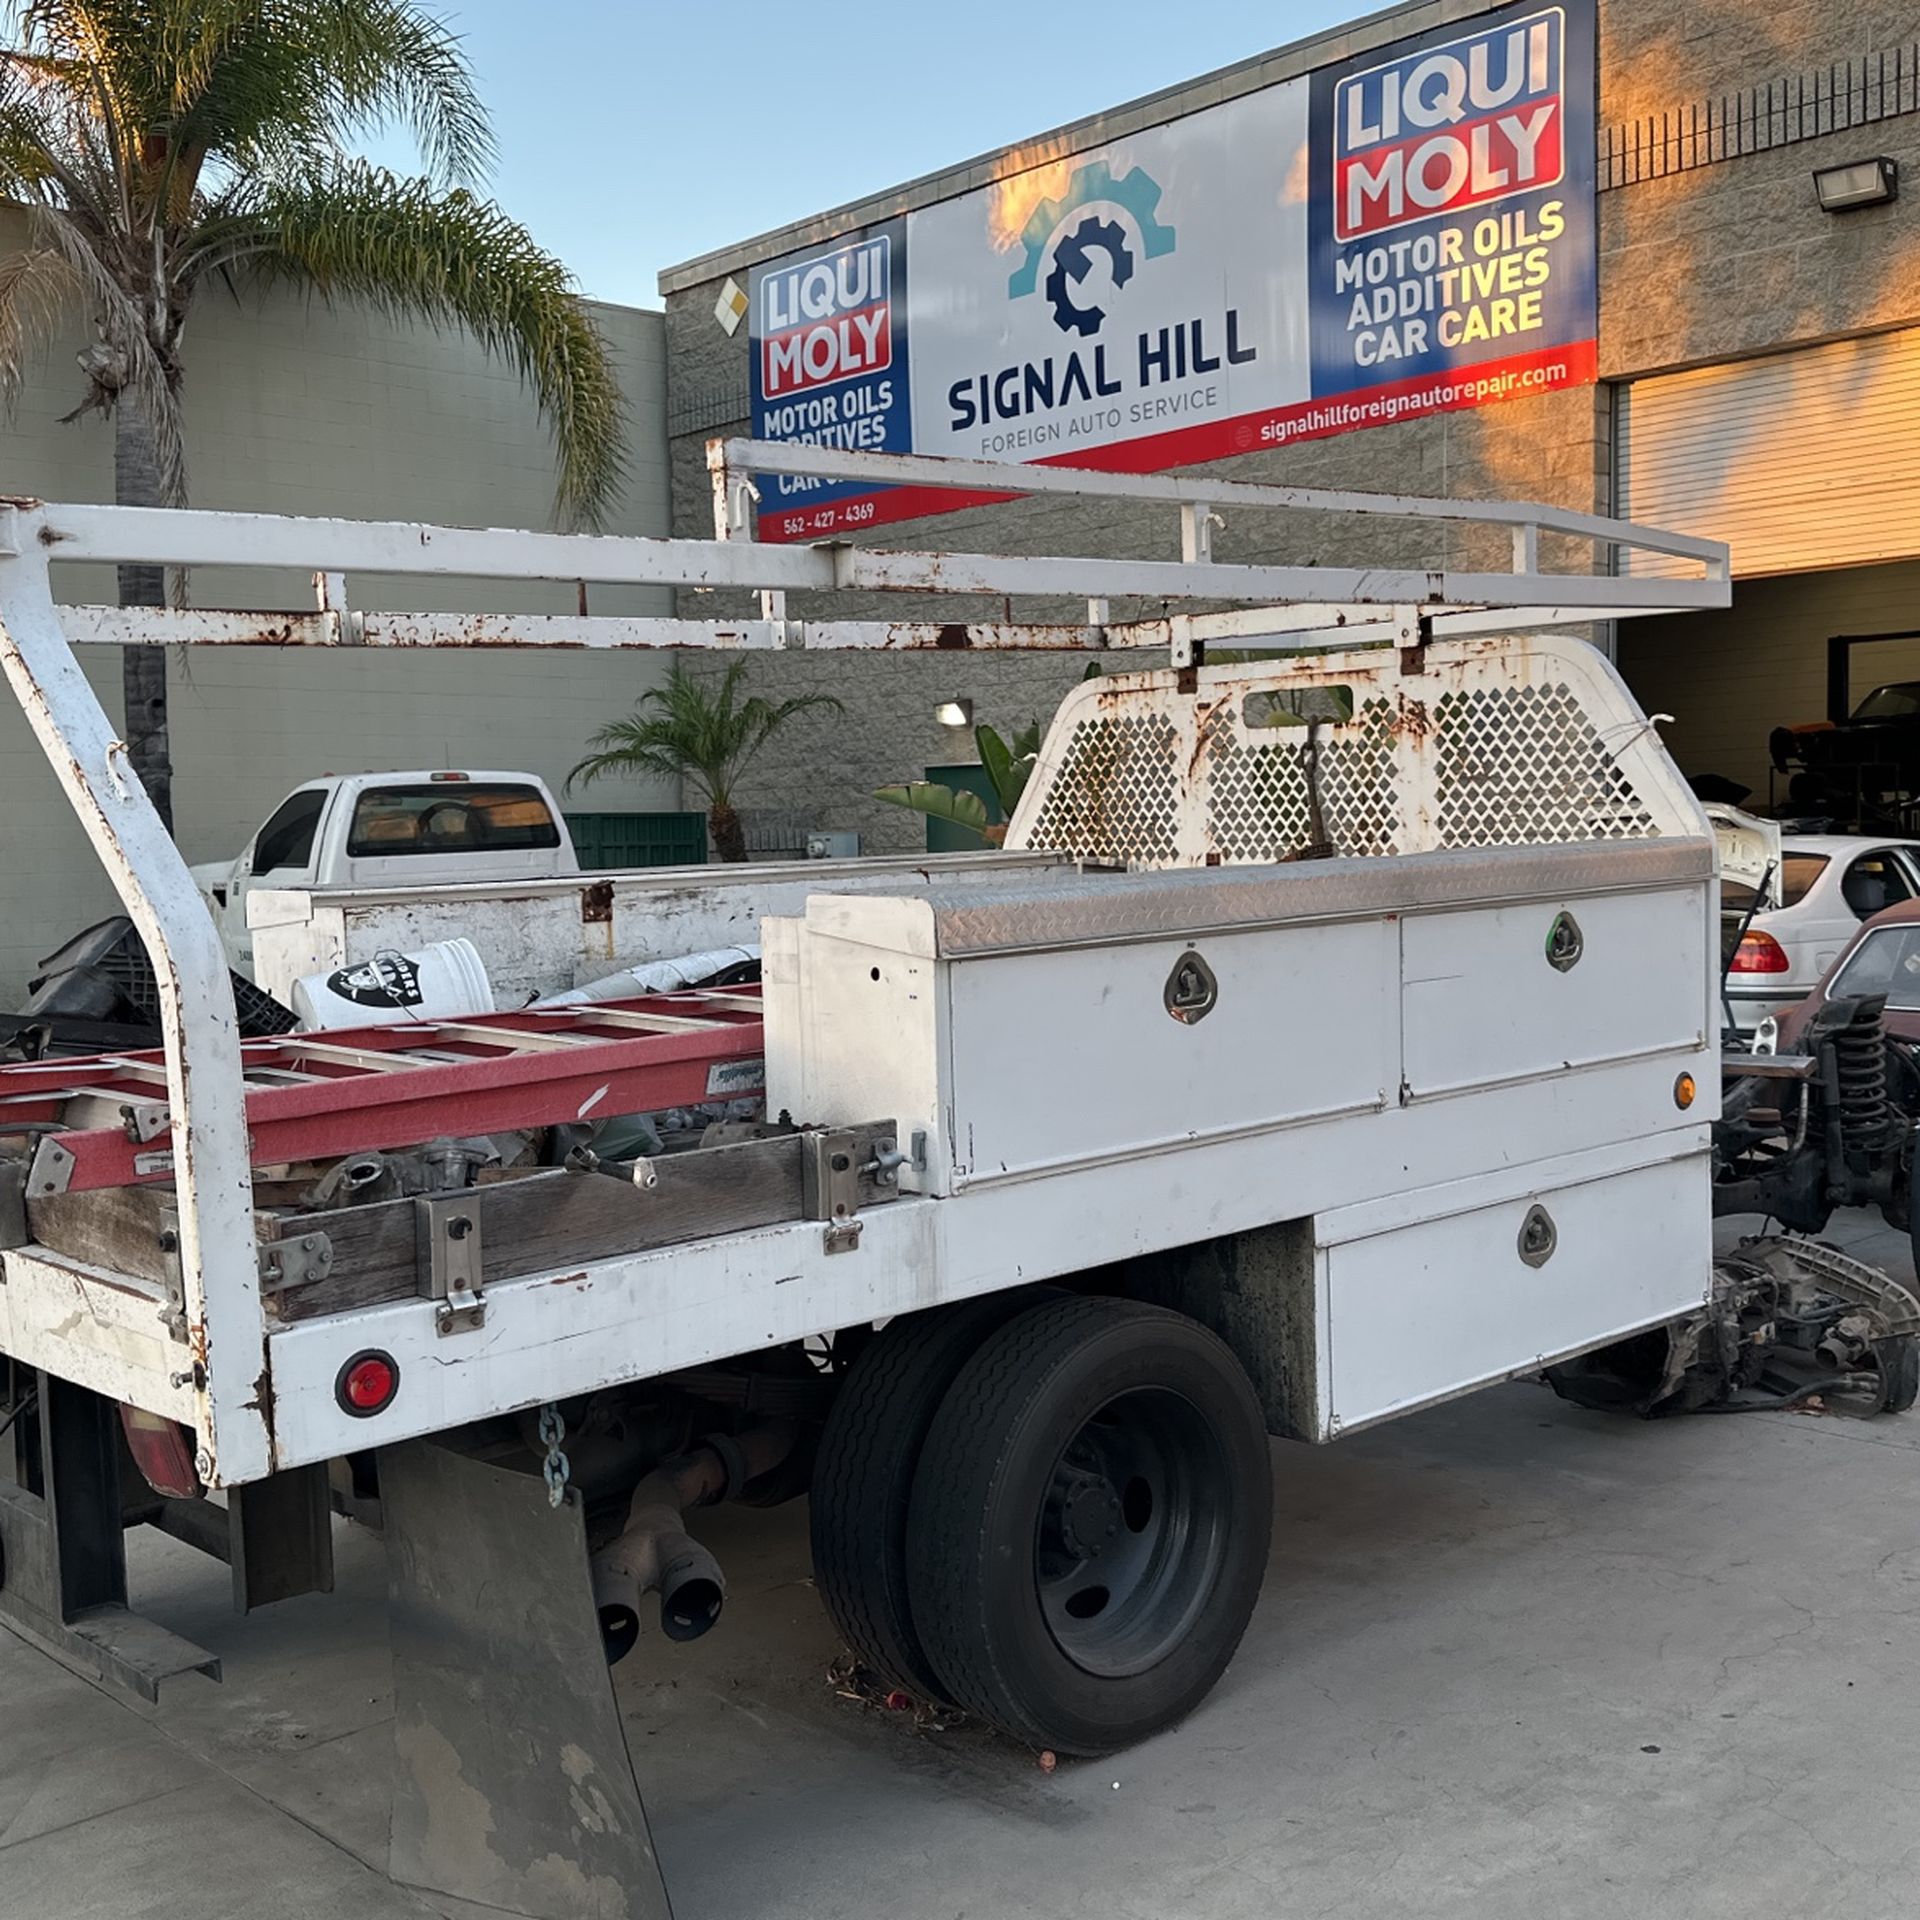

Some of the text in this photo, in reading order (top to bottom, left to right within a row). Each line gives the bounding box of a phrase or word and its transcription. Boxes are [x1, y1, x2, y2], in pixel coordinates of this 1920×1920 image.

[1347, 21, 1549, 151] LIQUI
[1347, 103, 1557, 229] MOLY
[769, 246, 882, 331] LIQUI
[1336, 200, 1565, 294] MOTOR OILS
[1347, 247, 1550, 332] ADDITIVES
[769, 308, 887, 391] MOLY
[948, 309, 1256, 432] SIGNAL HILL
[1354, 290, 1543, 367] CAR CARE
[764, 381, 893, 438] MOTOR OILS
[981, 386, 1217, 455] FOREIGN AUTO SERVICE
[1261, 362, 1566, 442] signalhillforeignautorepair.com
